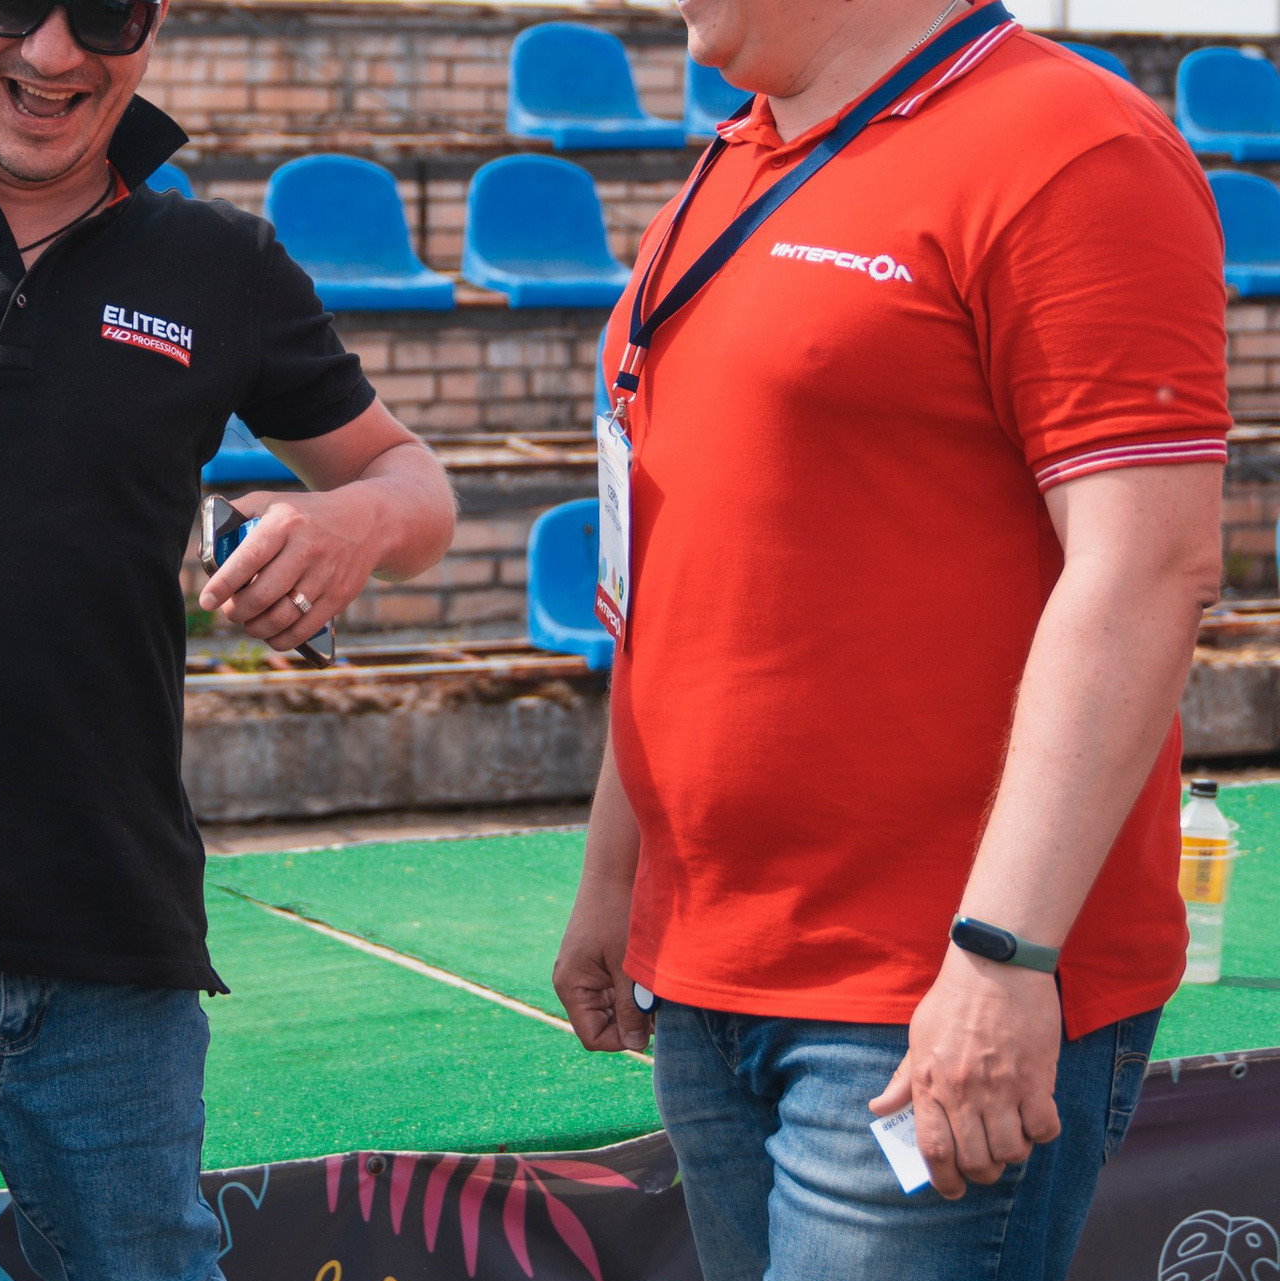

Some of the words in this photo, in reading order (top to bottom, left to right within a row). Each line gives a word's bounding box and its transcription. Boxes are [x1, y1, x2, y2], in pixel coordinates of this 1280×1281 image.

[770, 242, 913, 283] ИНТЕРСКОЛ
[102, 304, 193, 350] ELITECH
[103, 326, 131, 341] HD
[132, 334, 189, 364] PROFESSIONAL
